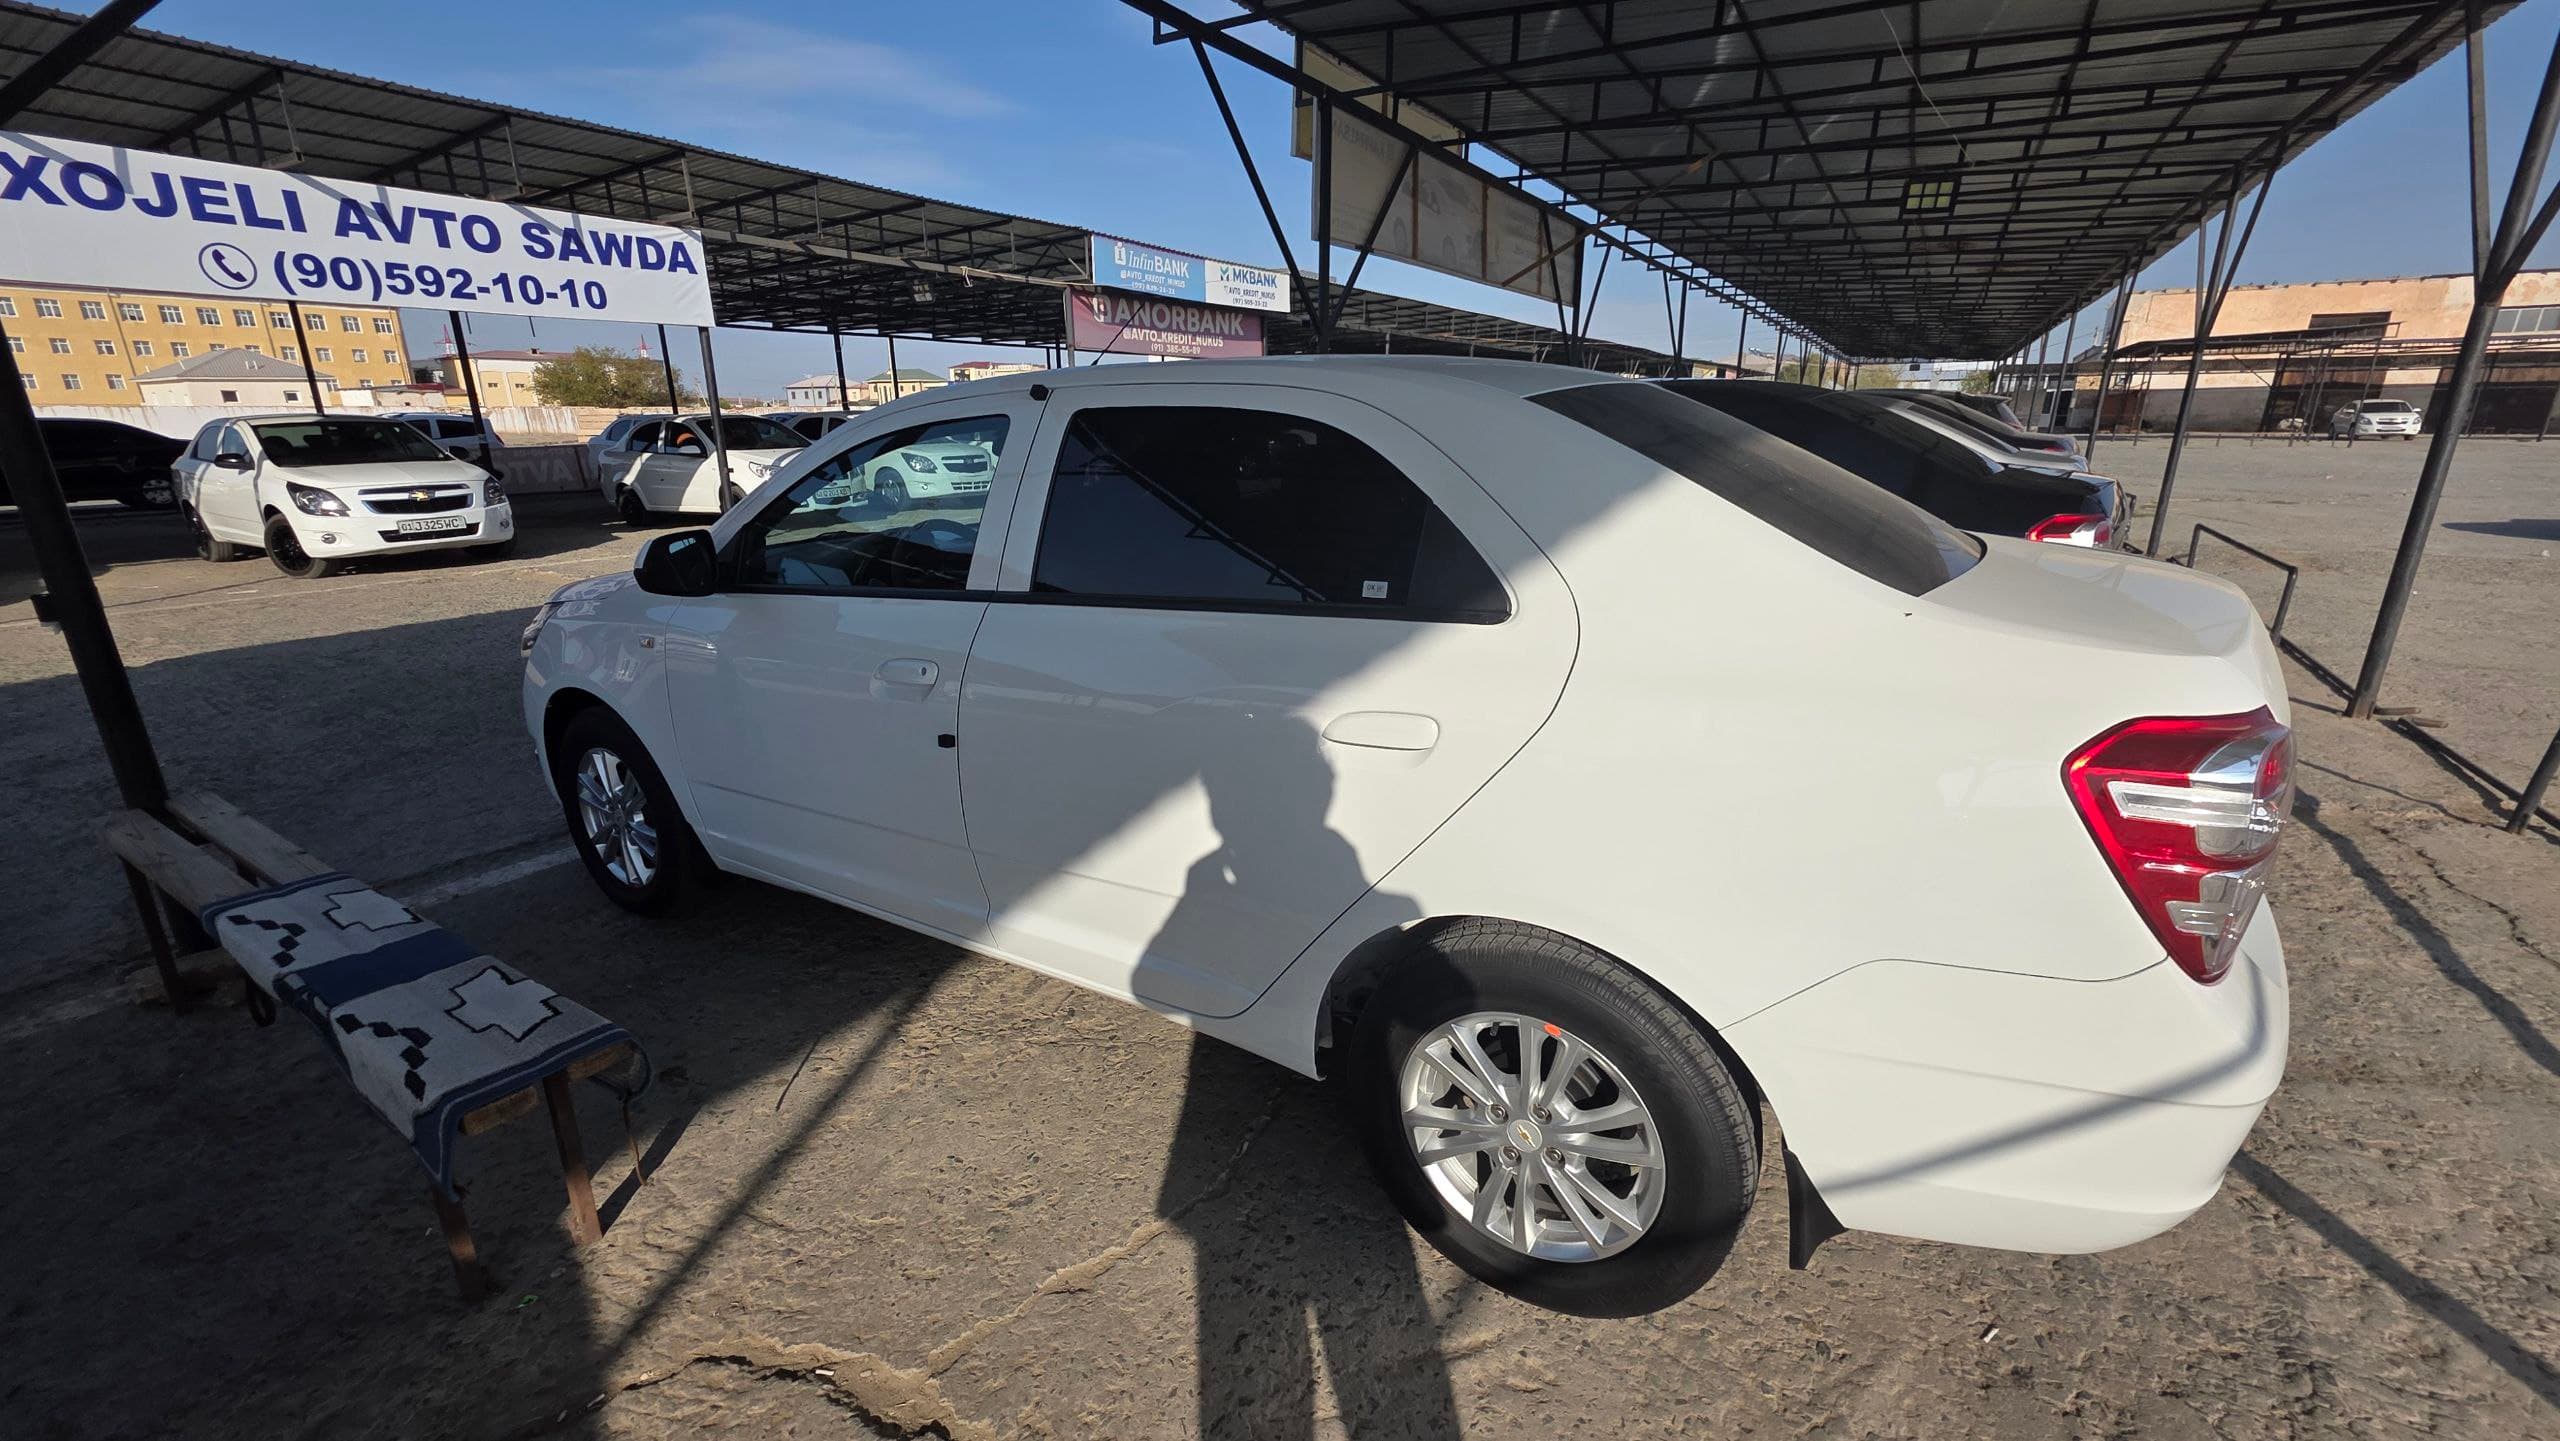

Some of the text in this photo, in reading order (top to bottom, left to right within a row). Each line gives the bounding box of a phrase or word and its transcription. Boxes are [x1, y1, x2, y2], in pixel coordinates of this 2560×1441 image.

[0, 150, 698, 275] XOJELI AVTO SAWDA
[273, 250, 609, 312] (90)592-10-10
[1233, 268, 1278, 288] MKBANK
[1115, 297, 1245, 336] ANORBANK
